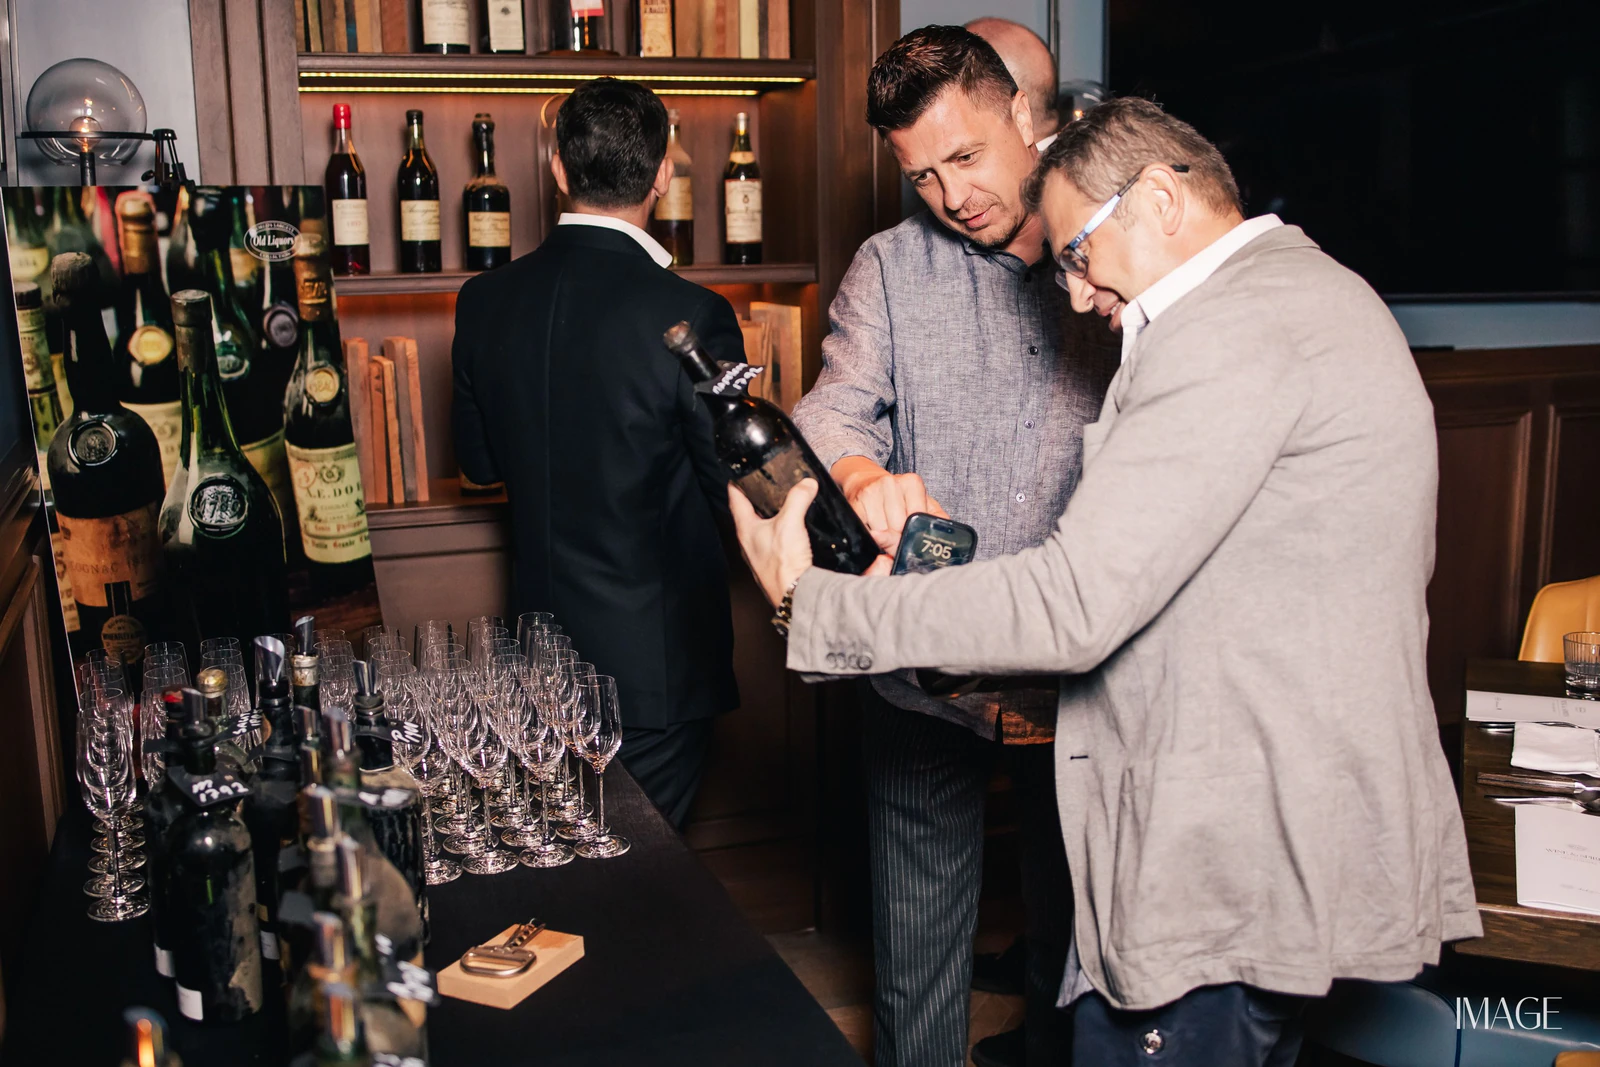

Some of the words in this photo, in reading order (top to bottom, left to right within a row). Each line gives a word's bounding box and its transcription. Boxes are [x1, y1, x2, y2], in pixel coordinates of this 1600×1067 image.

[253, 234, 266, 247] Old
[267, 234, 294, 248] Liquors
[921, 539, 952, 560] 7:05
[199, 781, 249, 803] 1792
